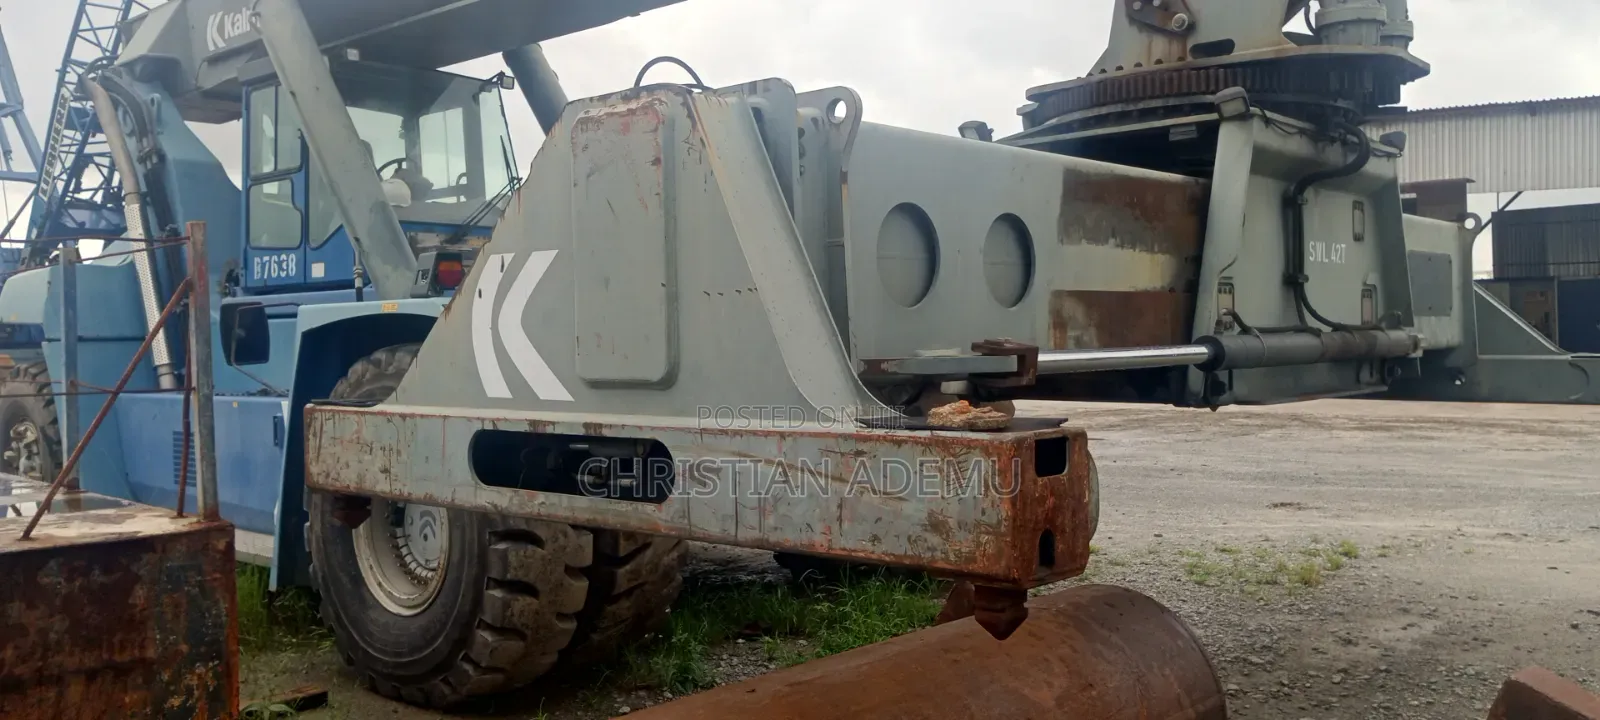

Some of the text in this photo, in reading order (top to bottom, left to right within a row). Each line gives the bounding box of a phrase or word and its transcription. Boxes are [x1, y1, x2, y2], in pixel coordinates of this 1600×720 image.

[40, 93, 69, 198] LIEBHERR
[1309, 241, 1346, 263] SWL 42T
[254, 253, 296, 279] B7638
